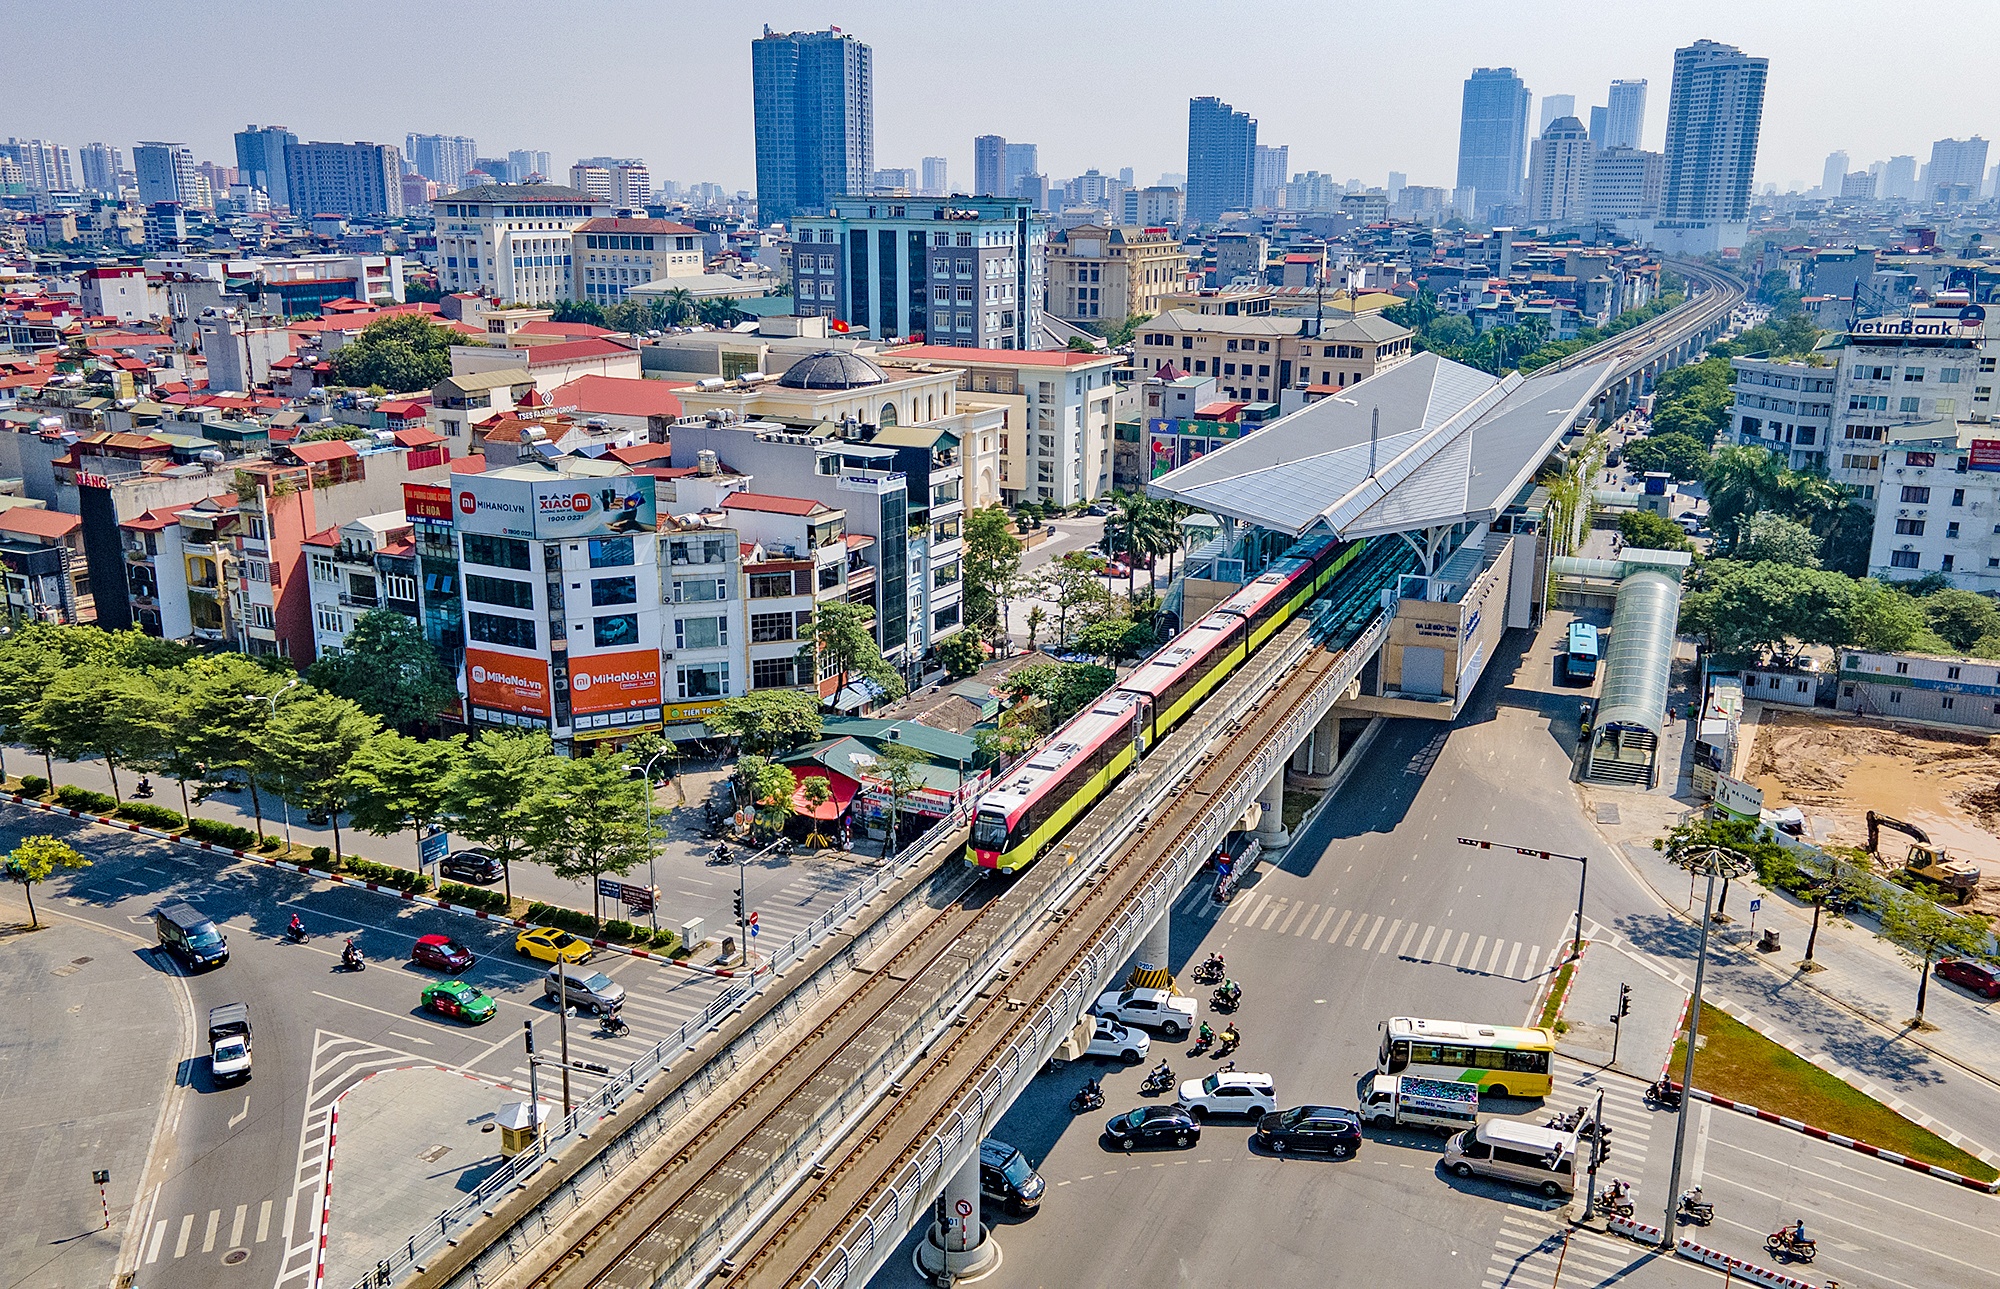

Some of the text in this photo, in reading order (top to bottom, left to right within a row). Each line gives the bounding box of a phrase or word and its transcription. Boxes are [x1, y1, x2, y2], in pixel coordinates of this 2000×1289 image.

[1845, 318, 1954, 336] VietinBank
[534, 407, 559, 418] FASHION
[477, 500, 525, 514] MIHANOI.VN
[486, 671, 542, 689] MiHaNoi.vn
[592, 670, 657, 685] MiHaNoi.vn
